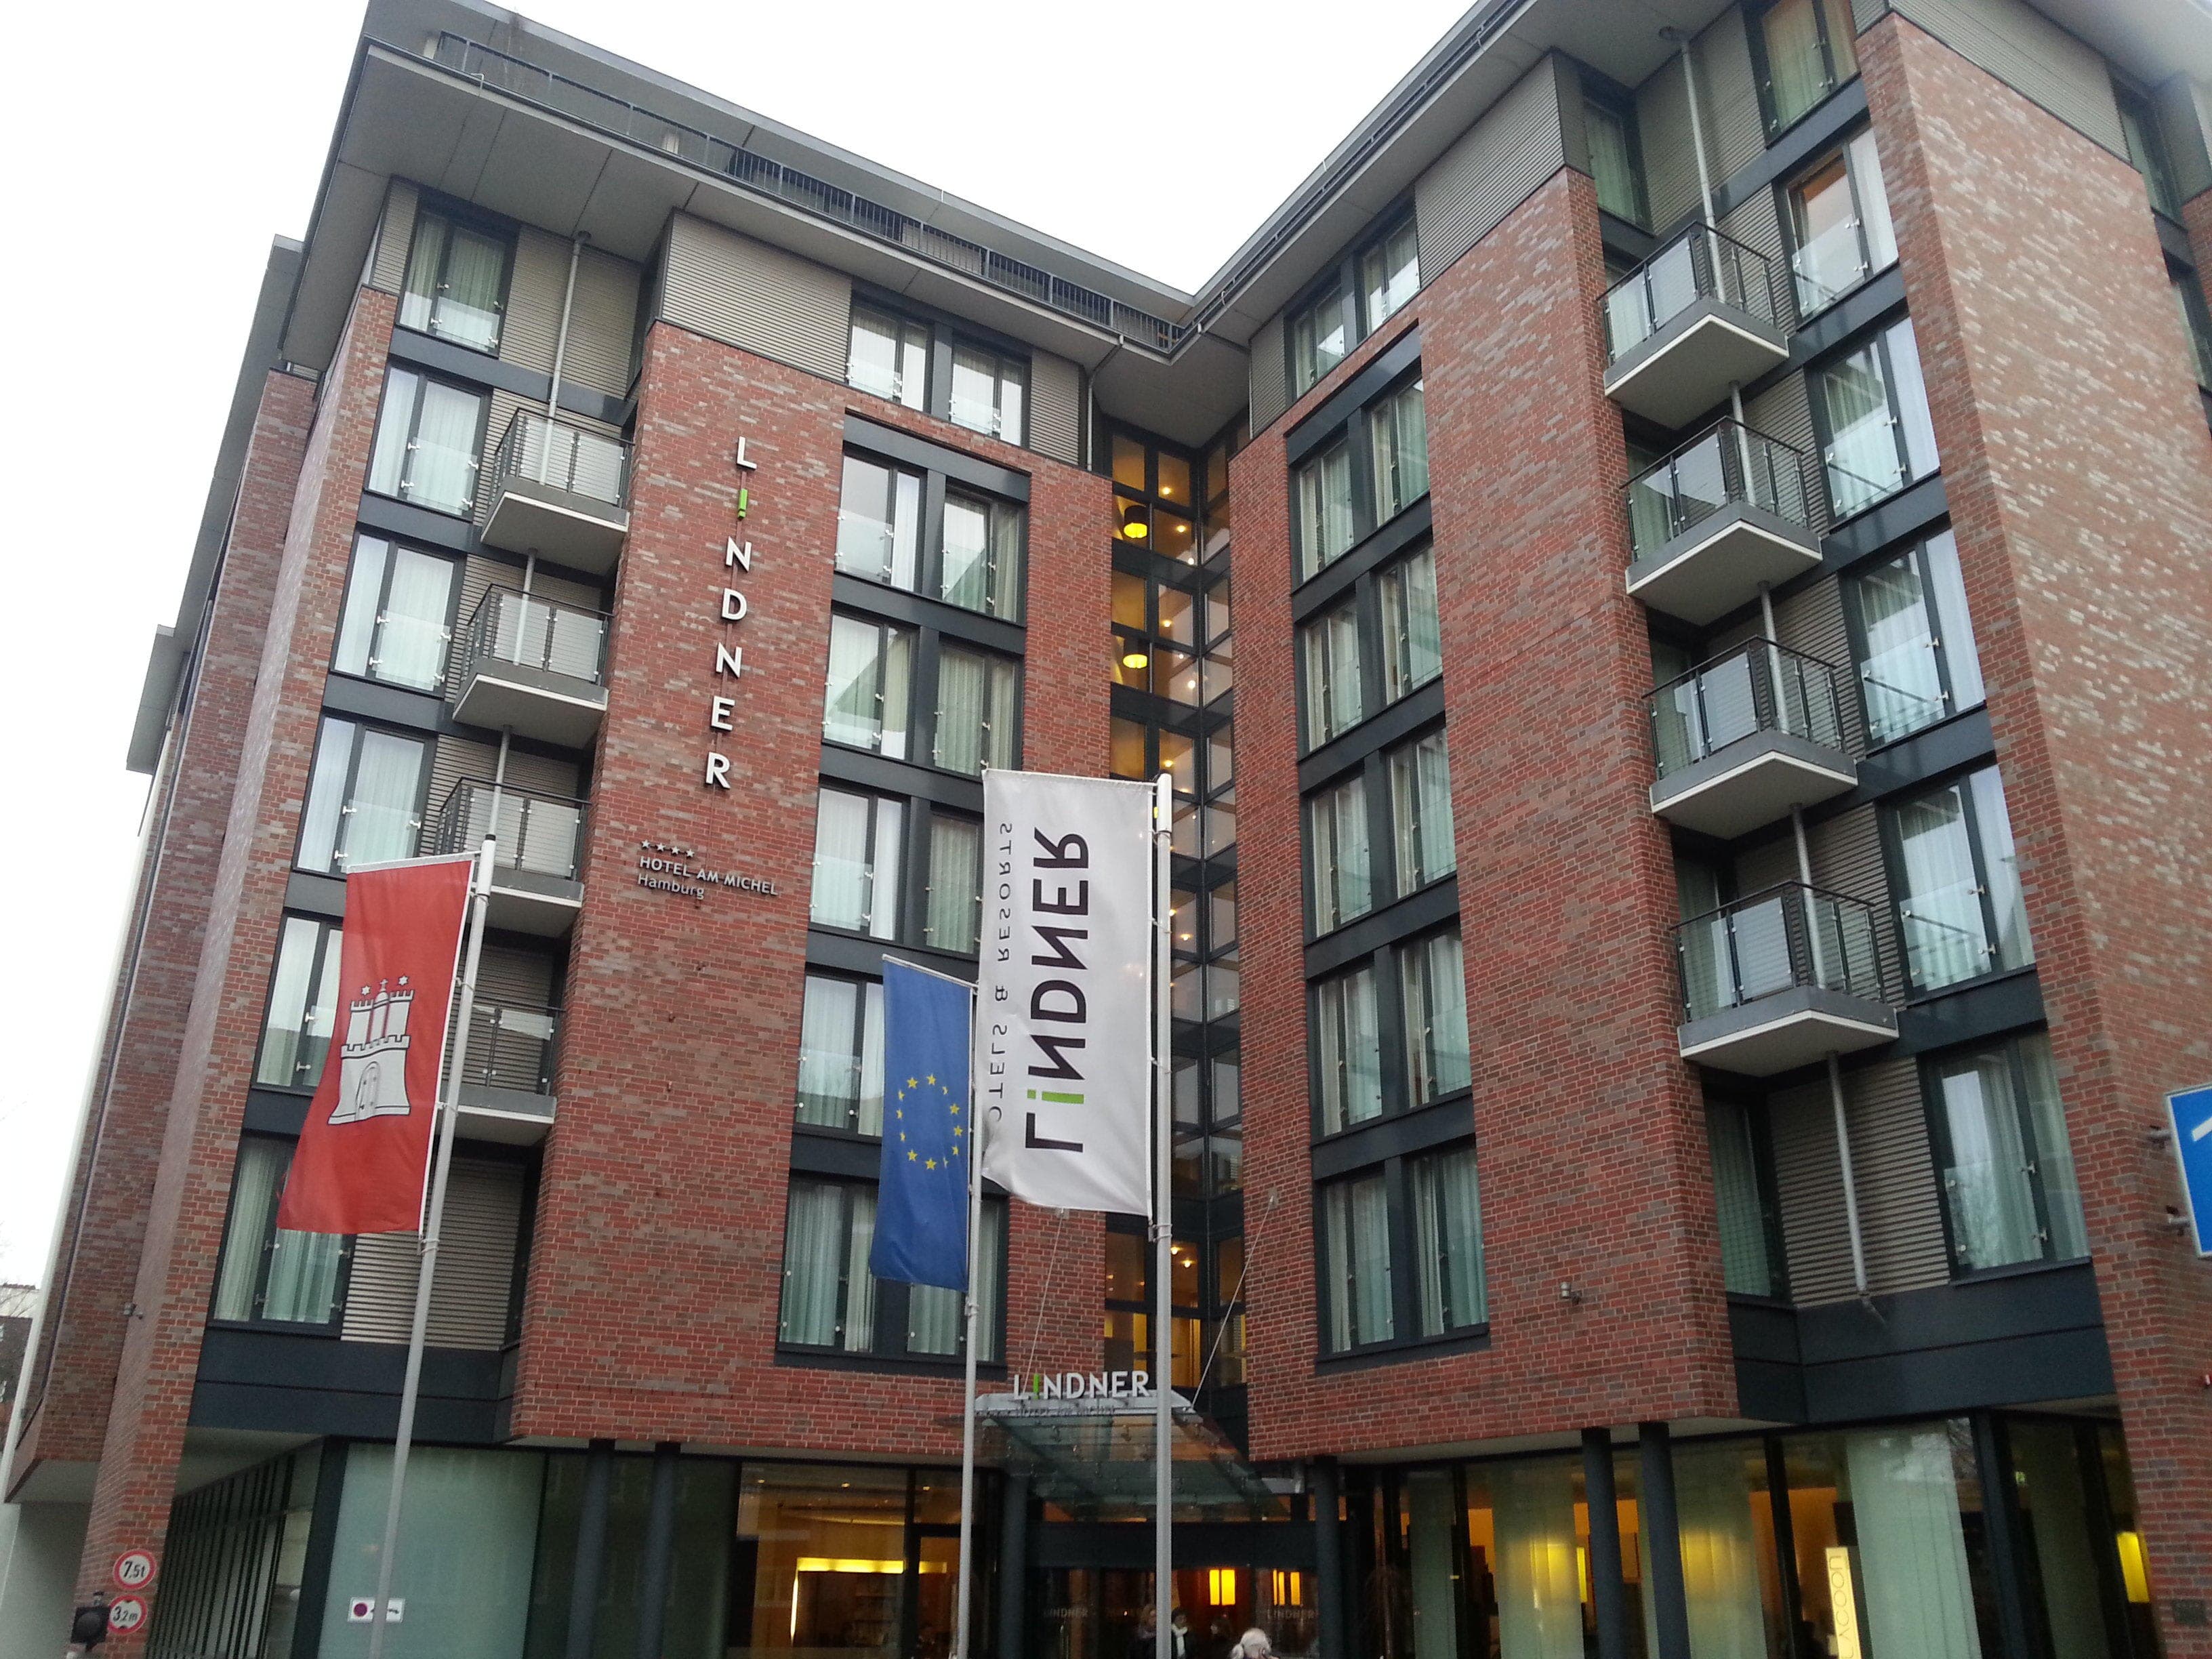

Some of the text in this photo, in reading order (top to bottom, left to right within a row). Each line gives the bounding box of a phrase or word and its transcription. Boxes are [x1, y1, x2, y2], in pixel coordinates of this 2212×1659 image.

[705, 436, 757, 790] LINDNER
[638, 873, 705, 900] Hamburg
[640, 856, 779, 896] HOTEL AM MICHEL
[1013, 1370, 1151, 1400] LINDNER
